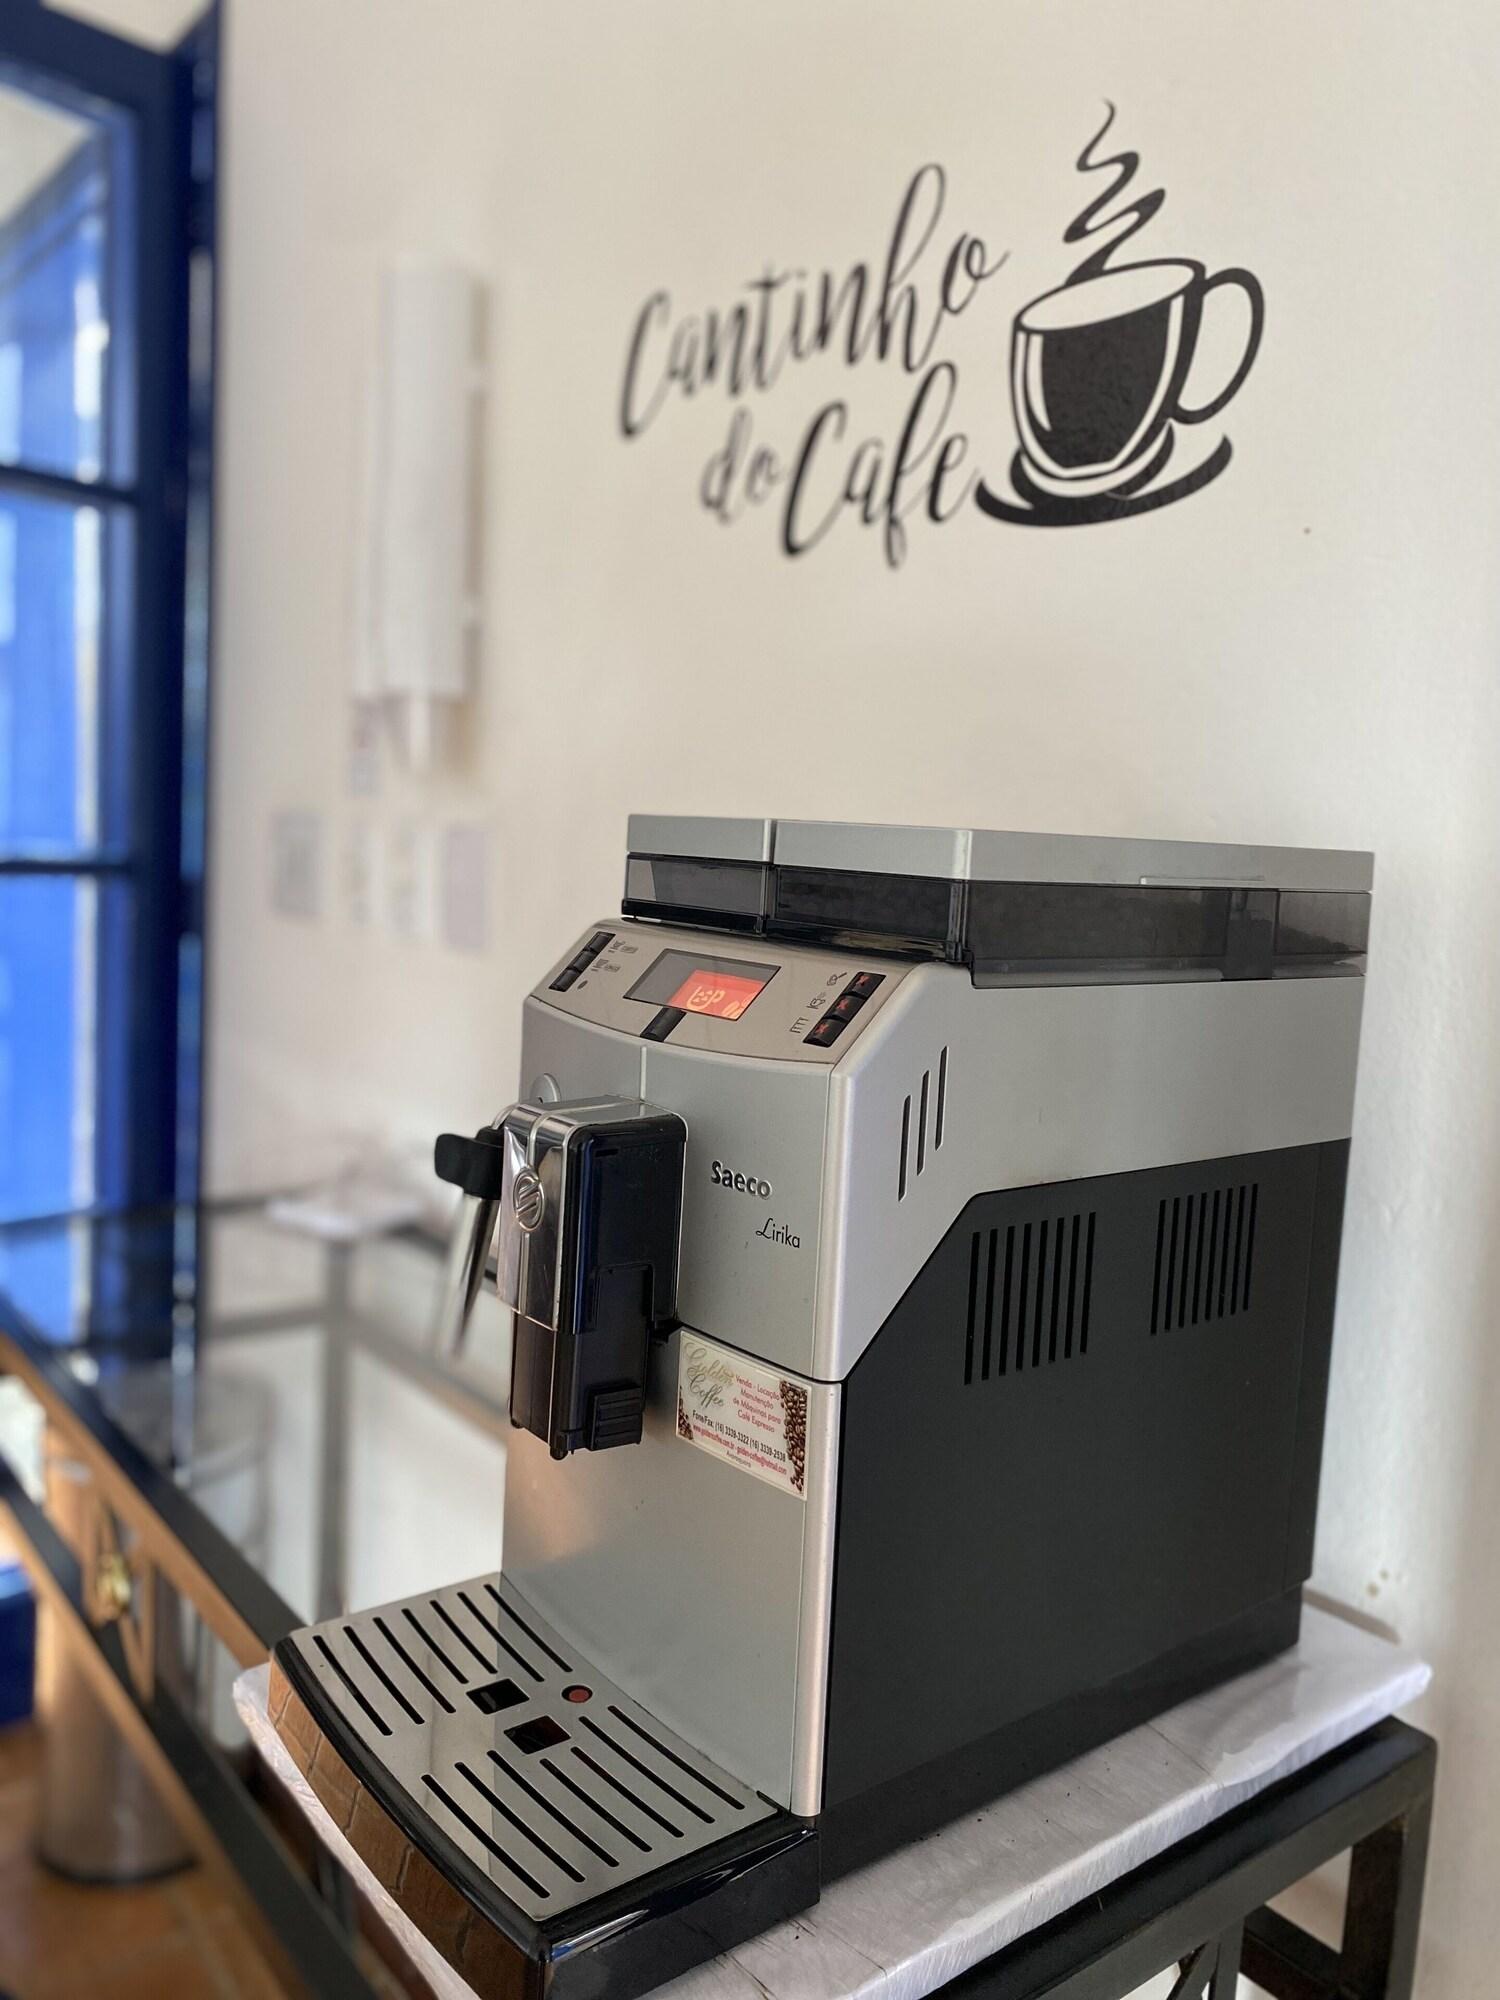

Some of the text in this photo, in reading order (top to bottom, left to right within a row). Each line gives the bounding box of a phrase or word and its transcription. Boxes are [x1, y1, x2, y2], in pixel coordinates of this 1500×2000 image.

[619, 163, 1010, 441] Cantinho
[701, 406, 784, 526] do
[710, 1160, 773, 1200] Saeco
[755, 1217, 801, 1249] Lirika
[684, 1342, 735, 1388] Golden
[687, 1373, 724, 1409] Coffee
[735, 1375, 753, 1389] Venda
[757, 1383, 780, 1401] Locação
[740, 1388, 773, 1409] Manutenção
[733, 1397, 782, 1425] de Máquinas para
[737, 1409, 775, 1433] Café Expresso
[714, 1421, 725, 1435] (16)
[725, 1426, 750, 1446] 3339-3322
[749, 1437, 760, 1452] (16)
